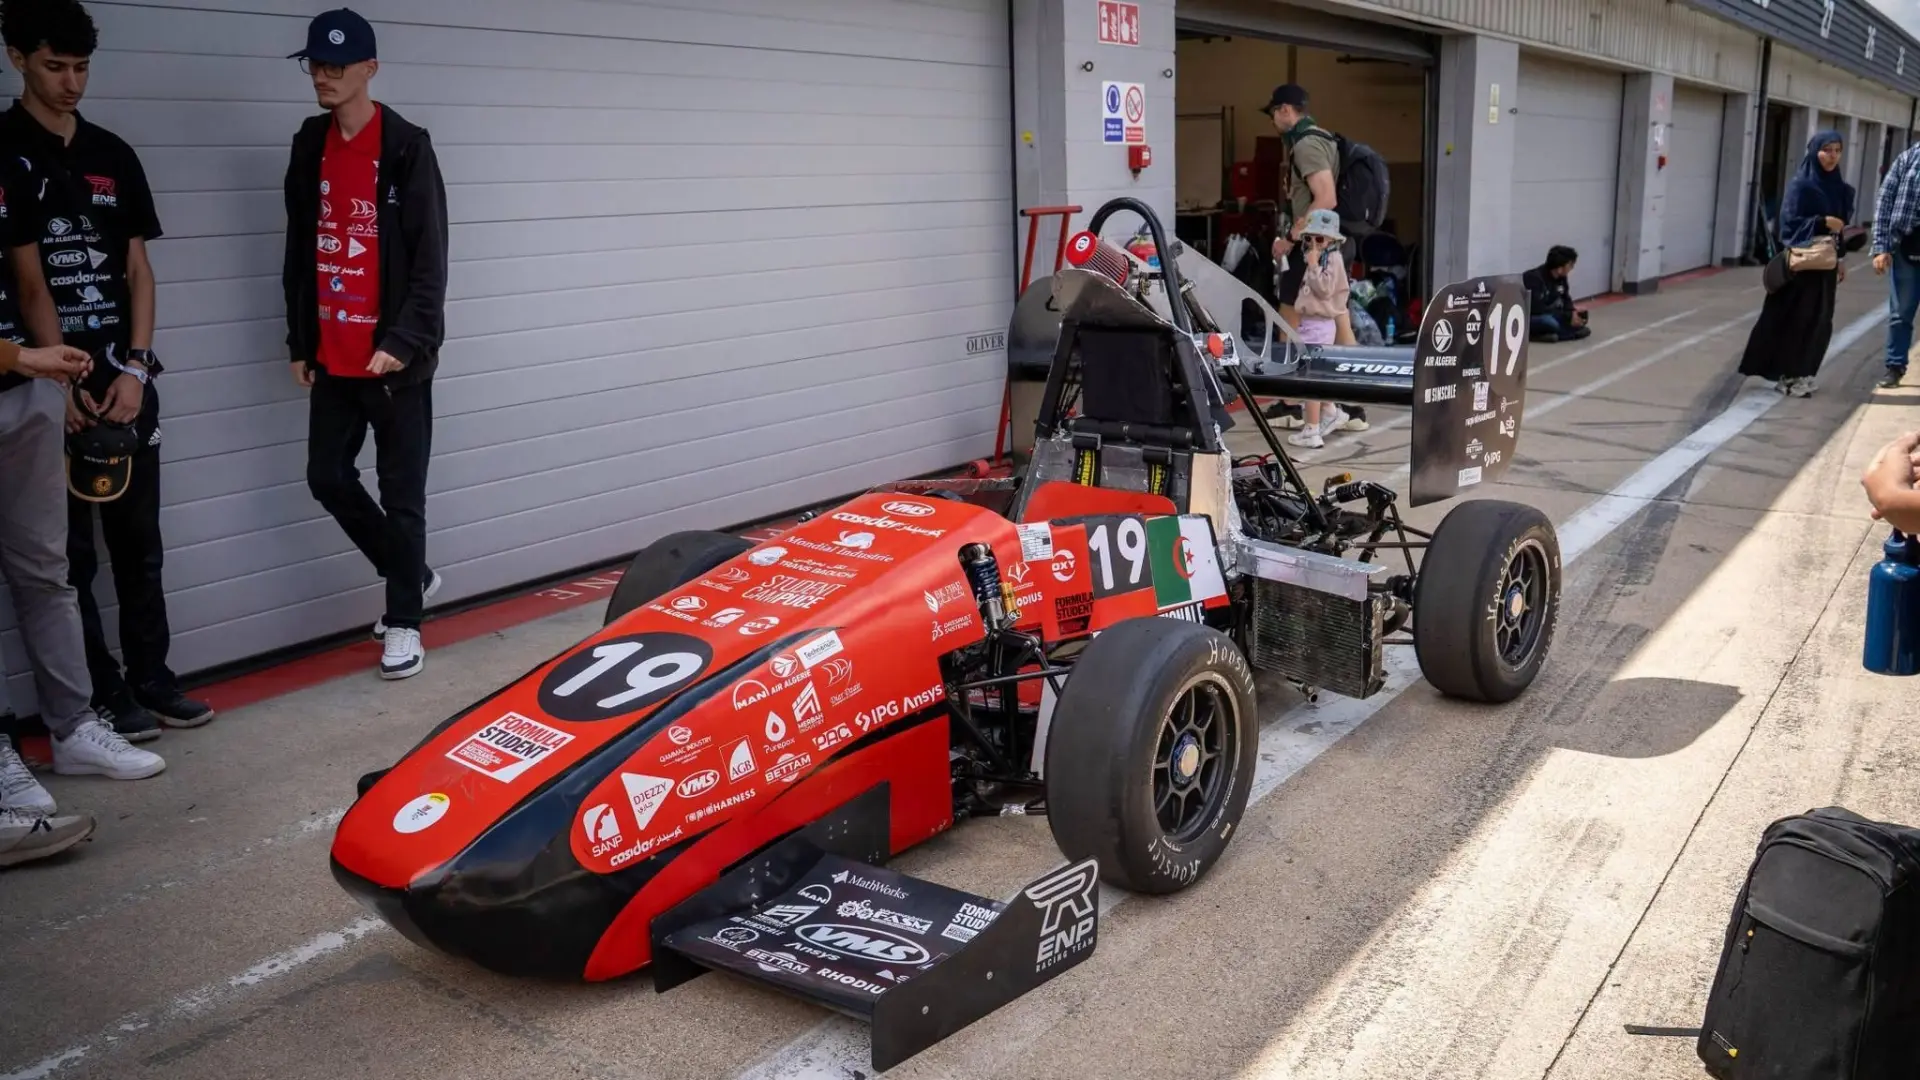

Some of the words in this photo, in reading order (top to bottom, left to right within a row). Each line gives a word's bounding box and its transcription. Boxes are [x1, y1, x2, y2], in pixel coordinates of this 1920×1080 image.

[92, 194, 117, 203] ENP
[52, 252, 83, 265] VMS
[1466, 322, 1481, 332] OXY
[966, 335, 1004, 352] OLIVER
[1488, 303, 1525, 376] 19
[1335, 363, 1414, 376] STUDE
[1425, 357, 1434, 367] AIR
[1434, 356, 1457, 367] ALGERIE
[1490, 451, 1501, 464] IPG
[886, 502, 932, 515] VMS
[784, 535, 839, 553] Mondial
[836, 547, 894, 563] Industrie
[1088, 518, 1146, 590] 19
[779, 560, 813, 572] TRANS
[1051, 560, 1076, 572] OXY
[761, 575, 847, 598] STUDENT
[648, 604, 665, 613] AIR
[1016, 592, 1043, 607] ODIUS
[1055, 591, 1095, 608] FORMULA
[1055, 602, 1094, 620] STUDENT
[743, 621, 776, 630] OXY
[553, 641, 703, 709] 19
[771, 682, 784, 695] AIR
[784, 669, 812, 689] ALGERIE
[736, 690, 768, 710] MAN
[871, 700, 899, 725] IPG
[903, 684, 943, 714] Ansys
[496, 714, 567, 749] FORMULA
[478, 726, 550, 759] STUDENT
[686, 735, 712, 751] INDUSTRY
[763, 738, 796, 754] Purepox
[731, 760, 752, 778] AGB
[765, 753, 811, 783] BETTAM
[633, 781, 668, 806] DJEZZY
[681, 771, 715, 796] VMS
[592, 834, 623, 857] SANP
[798, 890, 826, 904] MAN
[848, 874, 909, 900] MathWorks
[871, 910, 934, 932] FASM
[952, 912, 990, 930] STUD
[809, 926, 919, 961] VMS
[1036, 916, 1095, 964] ENP
[783, 941, 841, 961] Ansys
[1036, 950, 1069, 974] RACING
[1072, 936, 1094, 953] TEAM
[746, 949, 810, 975] BETTAM
[816, 967, 888, 995] RHODIU
